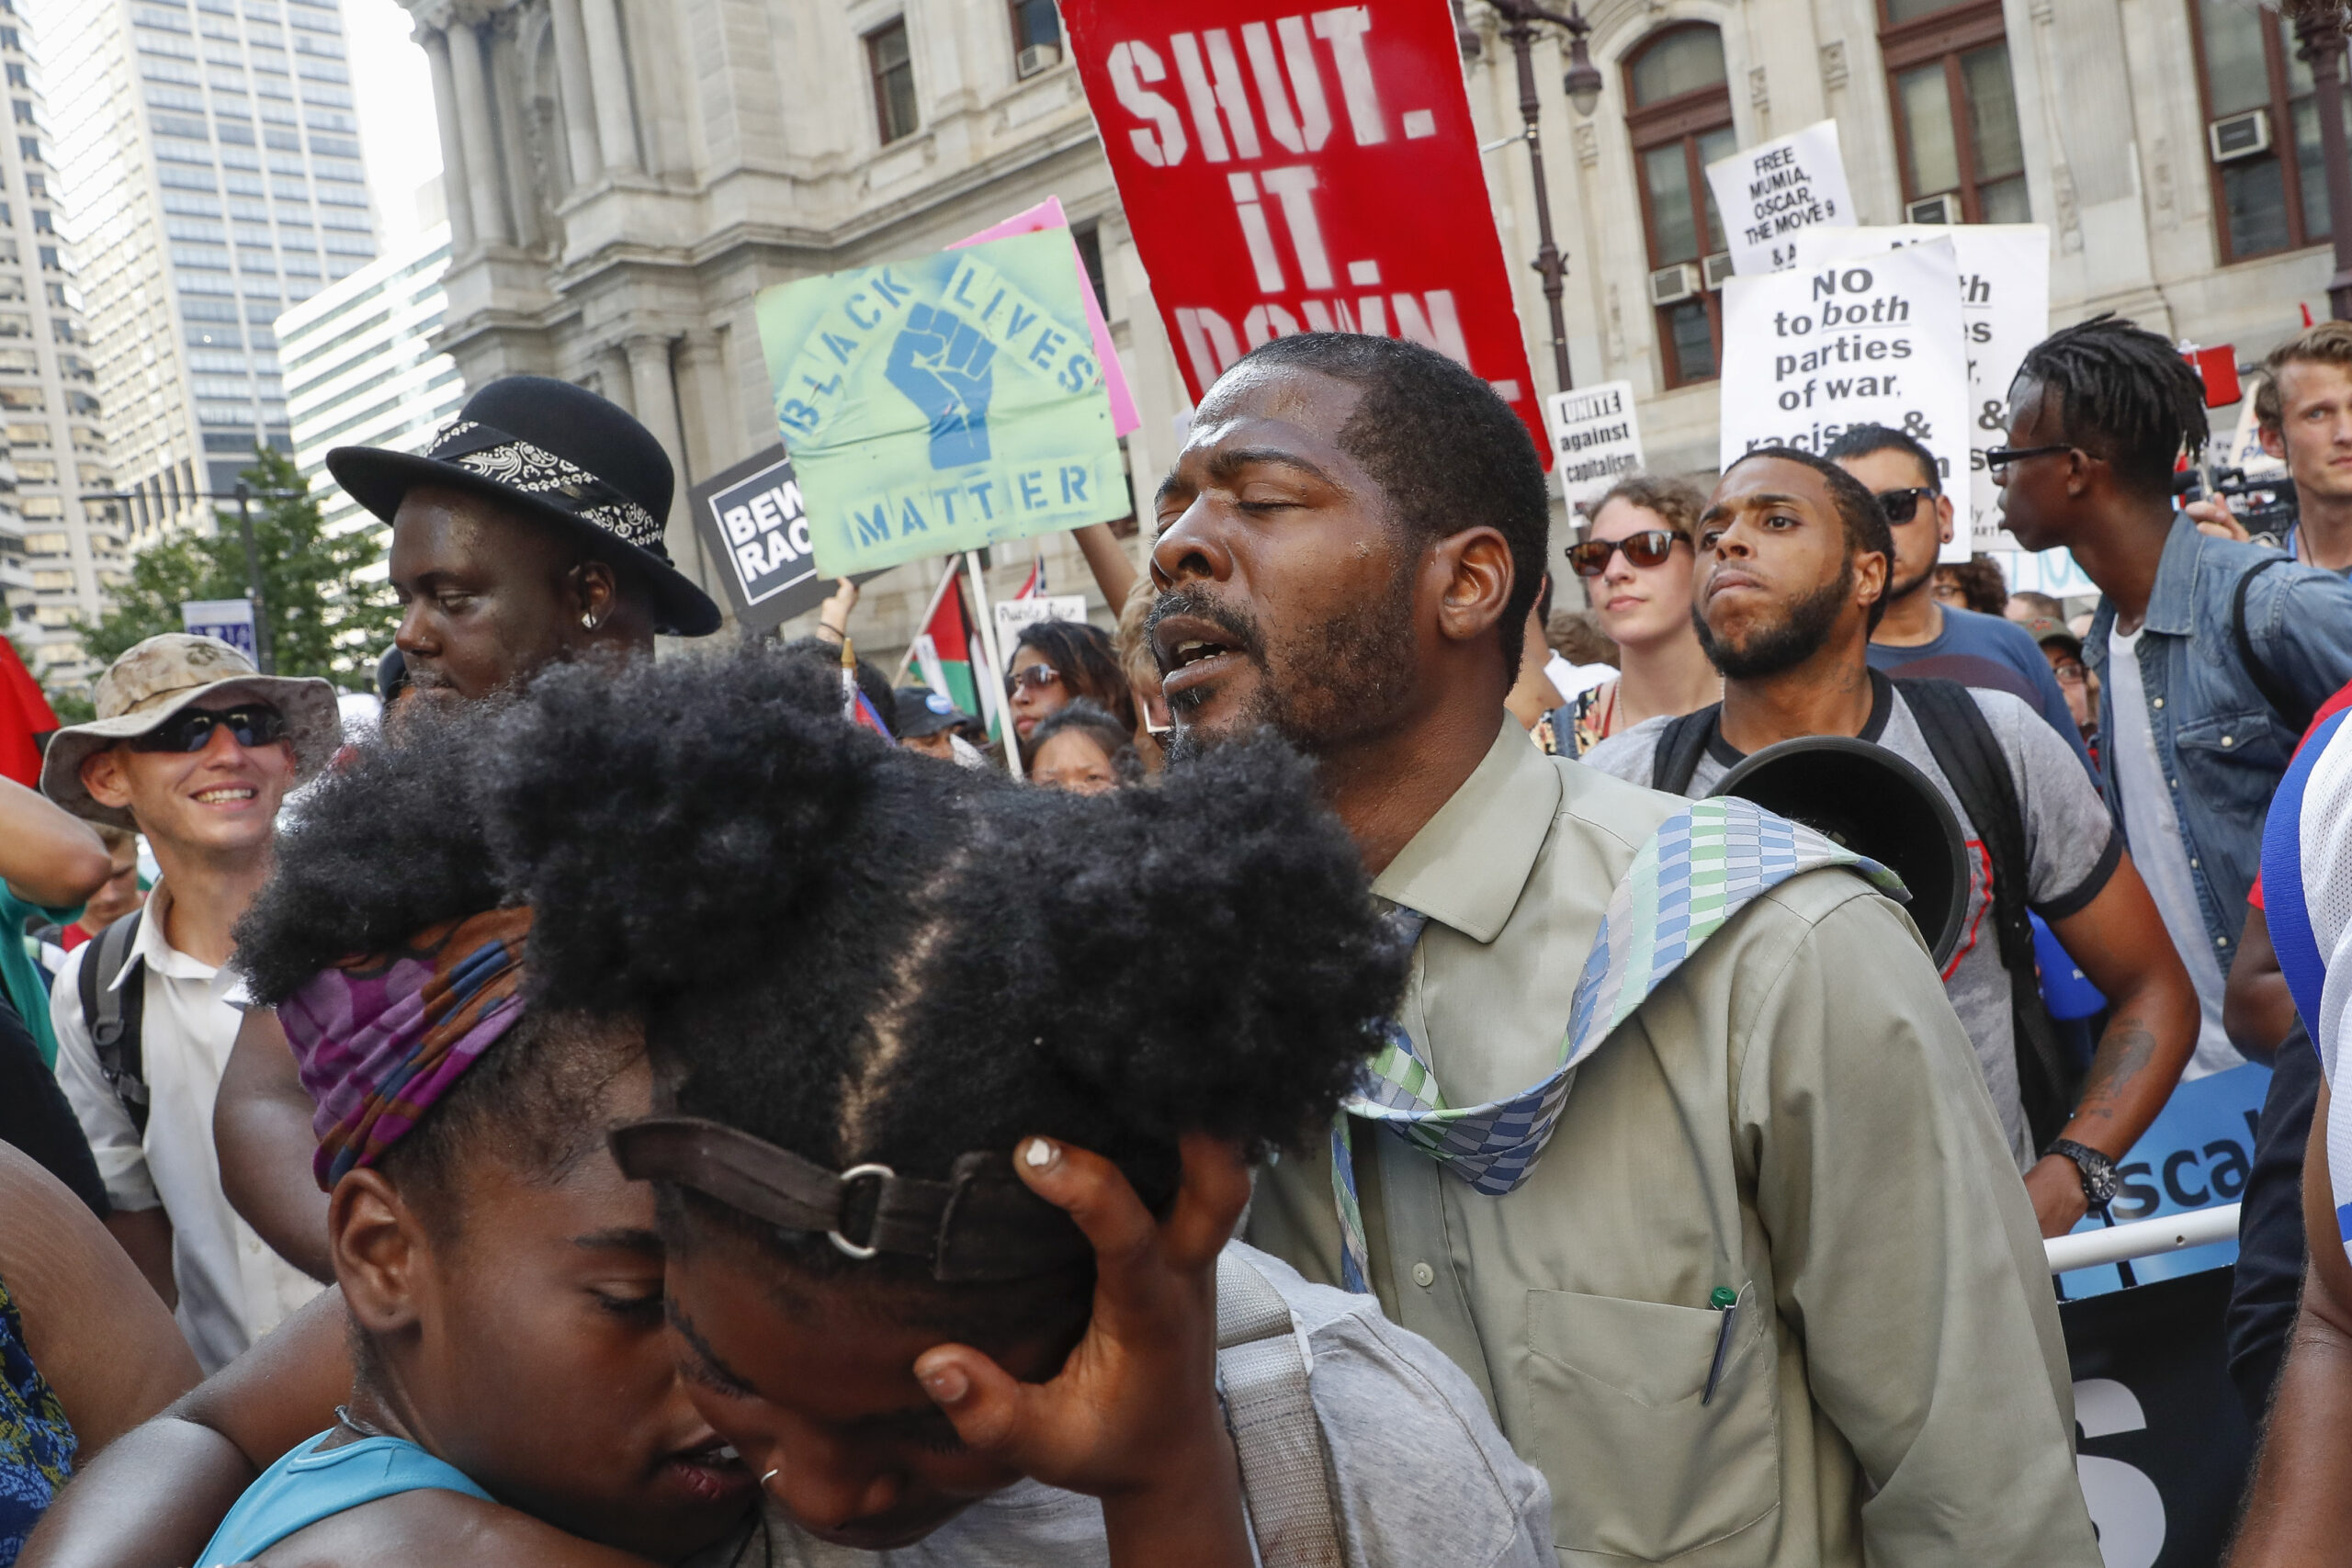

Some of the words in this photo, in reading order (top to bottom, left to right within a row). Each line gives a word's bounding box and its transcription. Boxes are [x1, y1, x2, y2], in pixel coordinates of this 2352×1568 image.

[1106, 5, 1436, 167] SHUT.
[1754, 146, 1794, 175] FREE
[1754, 186, 1815, 220] OSCAR,
[1745, 221, 1773, 245] THE
[1775, 203, 1826, 234] MOVE
[1813, 268, 1873, 301] NO
[1774, 311, 1813, 336] to
[1822, 295, 1909, 329] both
[780, 266, 912, 435] BLACK
[953, 267, 1093, 393] LIVES
[1775, 334, 1912, 381] parties
[1779, 379, 1816, 411] of
[1826, 375, 1901, 400] war,
[1561, 422, 1630, 451] against
[854, 465, 1089, 547] MATTER
